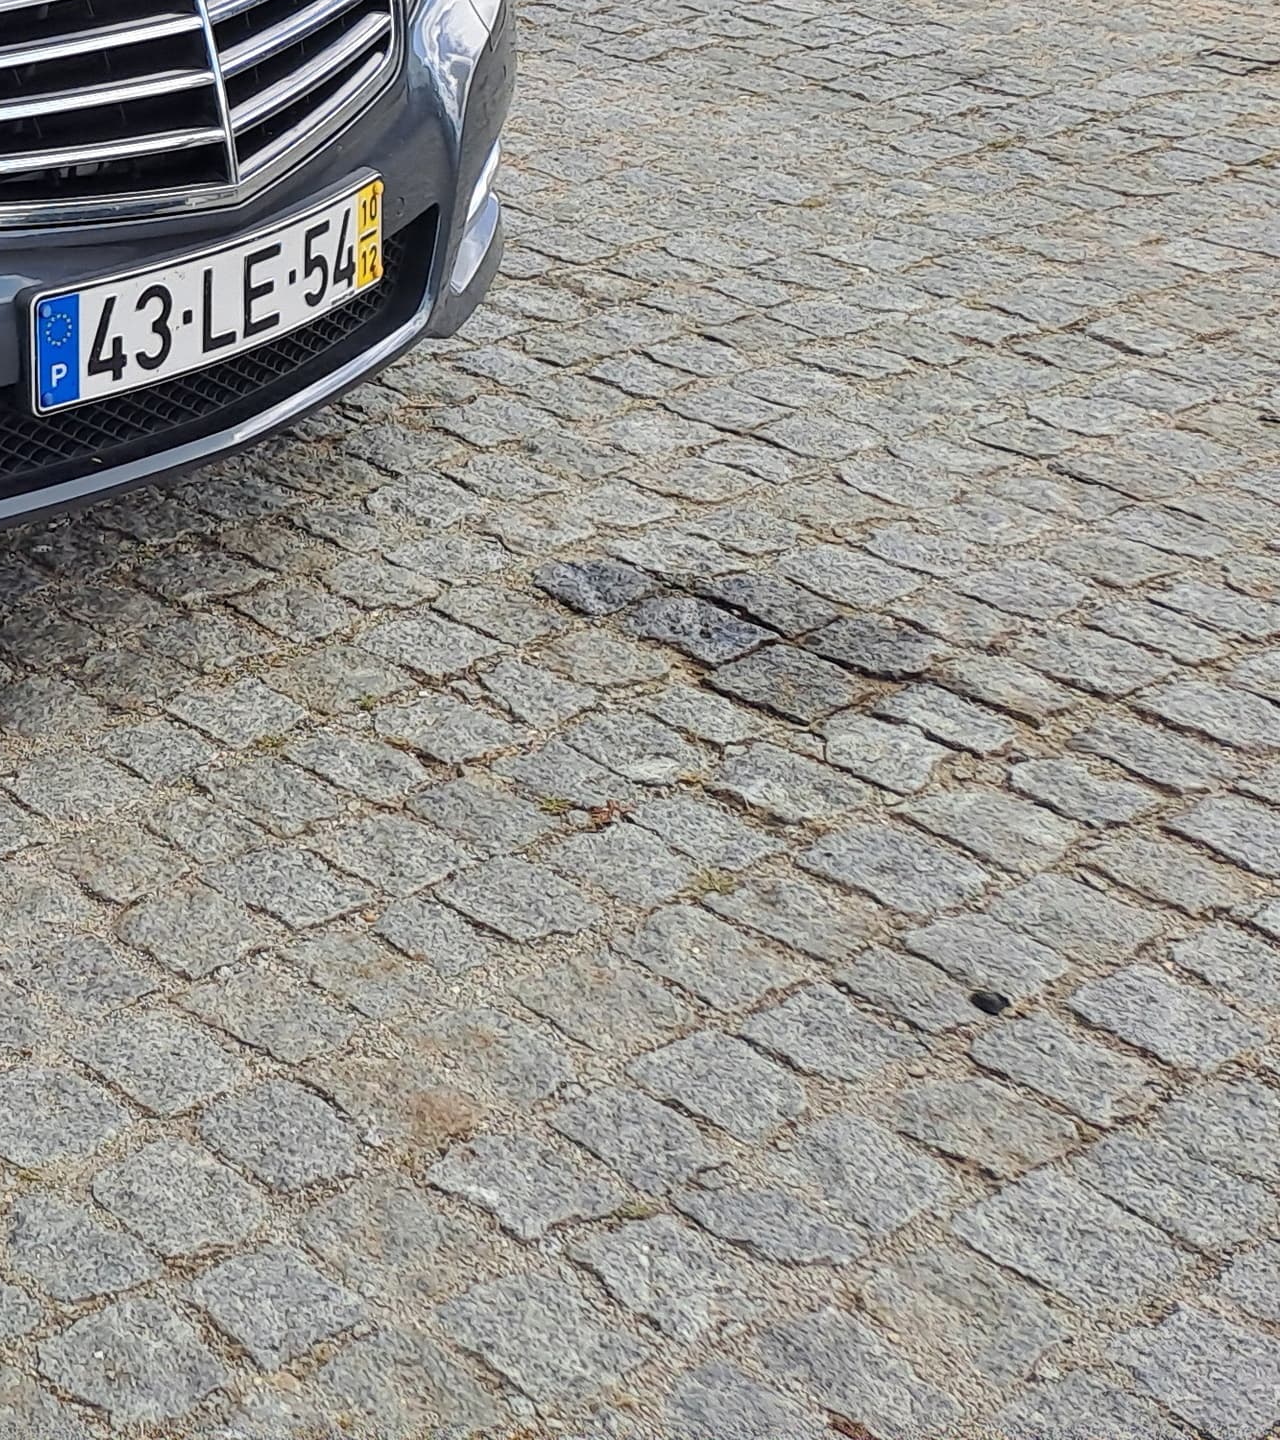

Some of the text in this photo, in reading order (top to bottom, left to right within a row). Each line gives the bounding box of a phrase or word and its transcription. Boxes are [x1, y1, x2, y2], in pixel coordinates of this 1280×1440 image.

[361, 194, 378, 227] 10
[361, 244, 378, 279] 12
[51, 362, 68, 389] P
